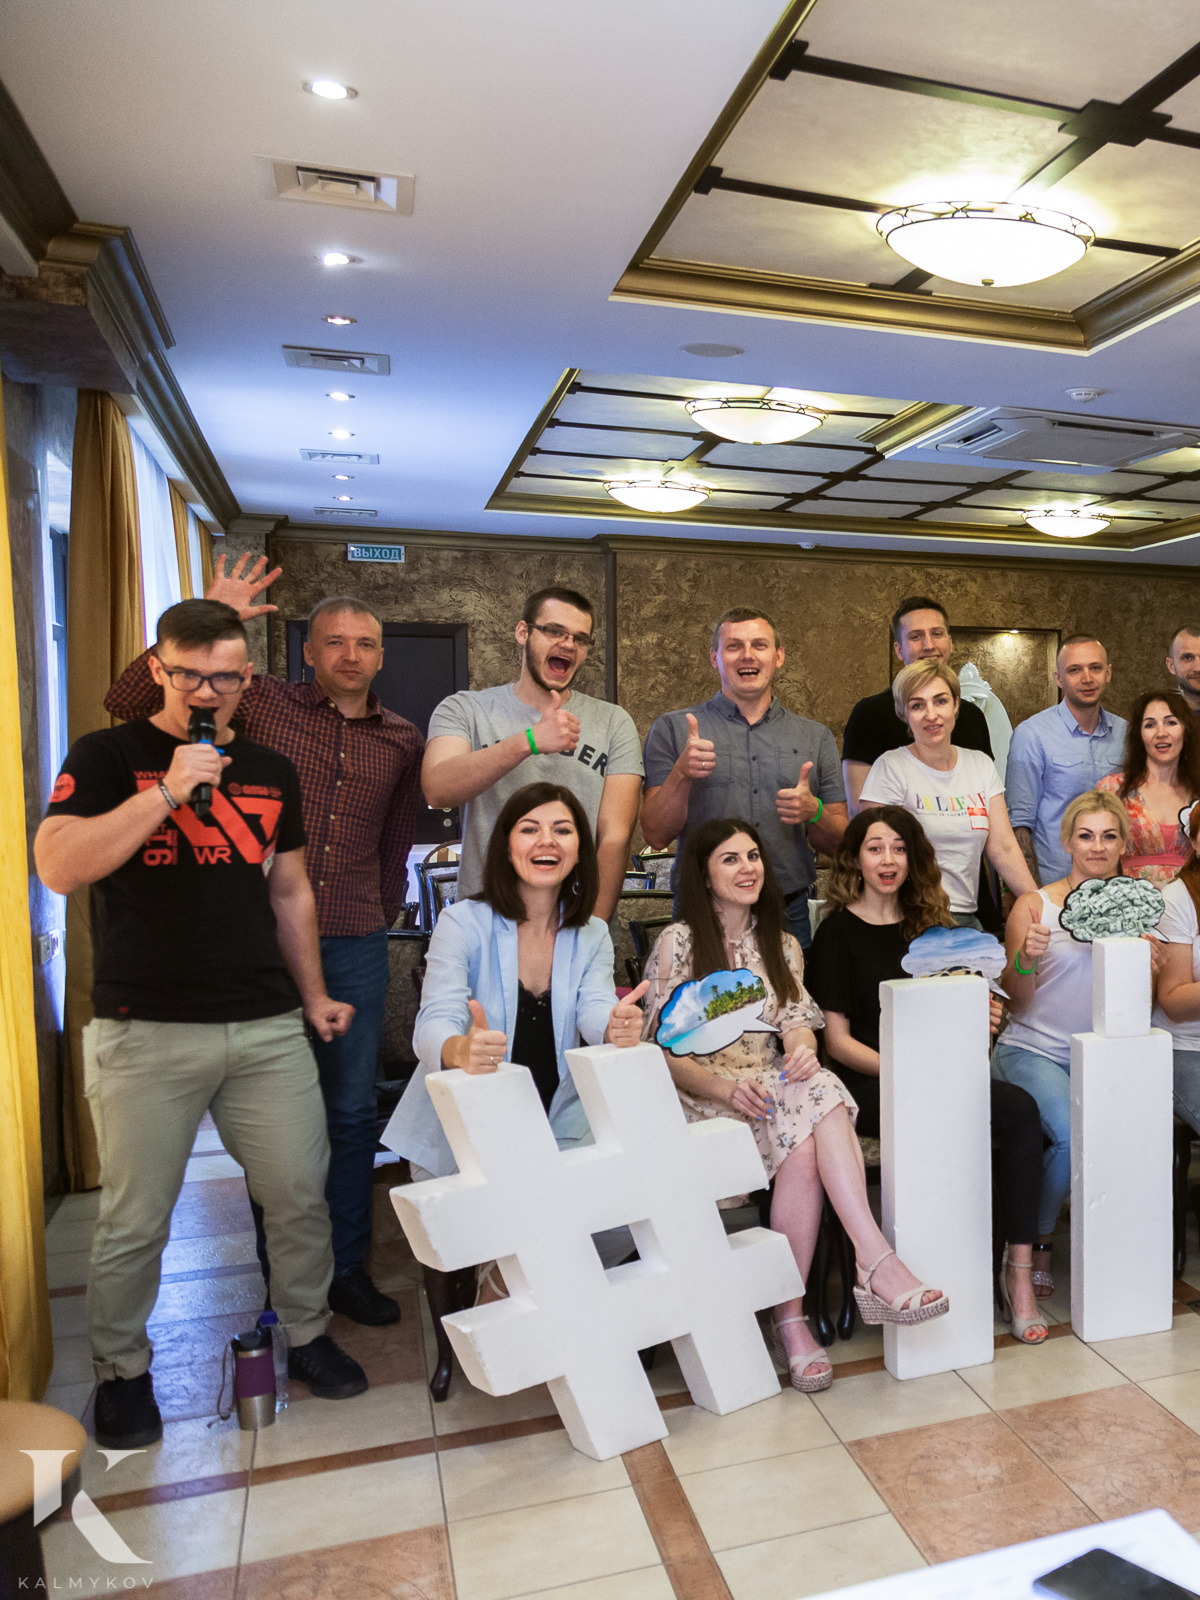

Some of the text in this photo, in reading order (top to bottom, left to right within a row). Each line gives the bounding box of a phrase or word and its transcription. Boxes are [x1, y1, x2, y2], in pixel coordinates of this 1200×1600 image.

[353, 547, 400, 560] ВЫХОД
[133, 770, 167, 780] WHA
[193, 846, 232, 865] WR
